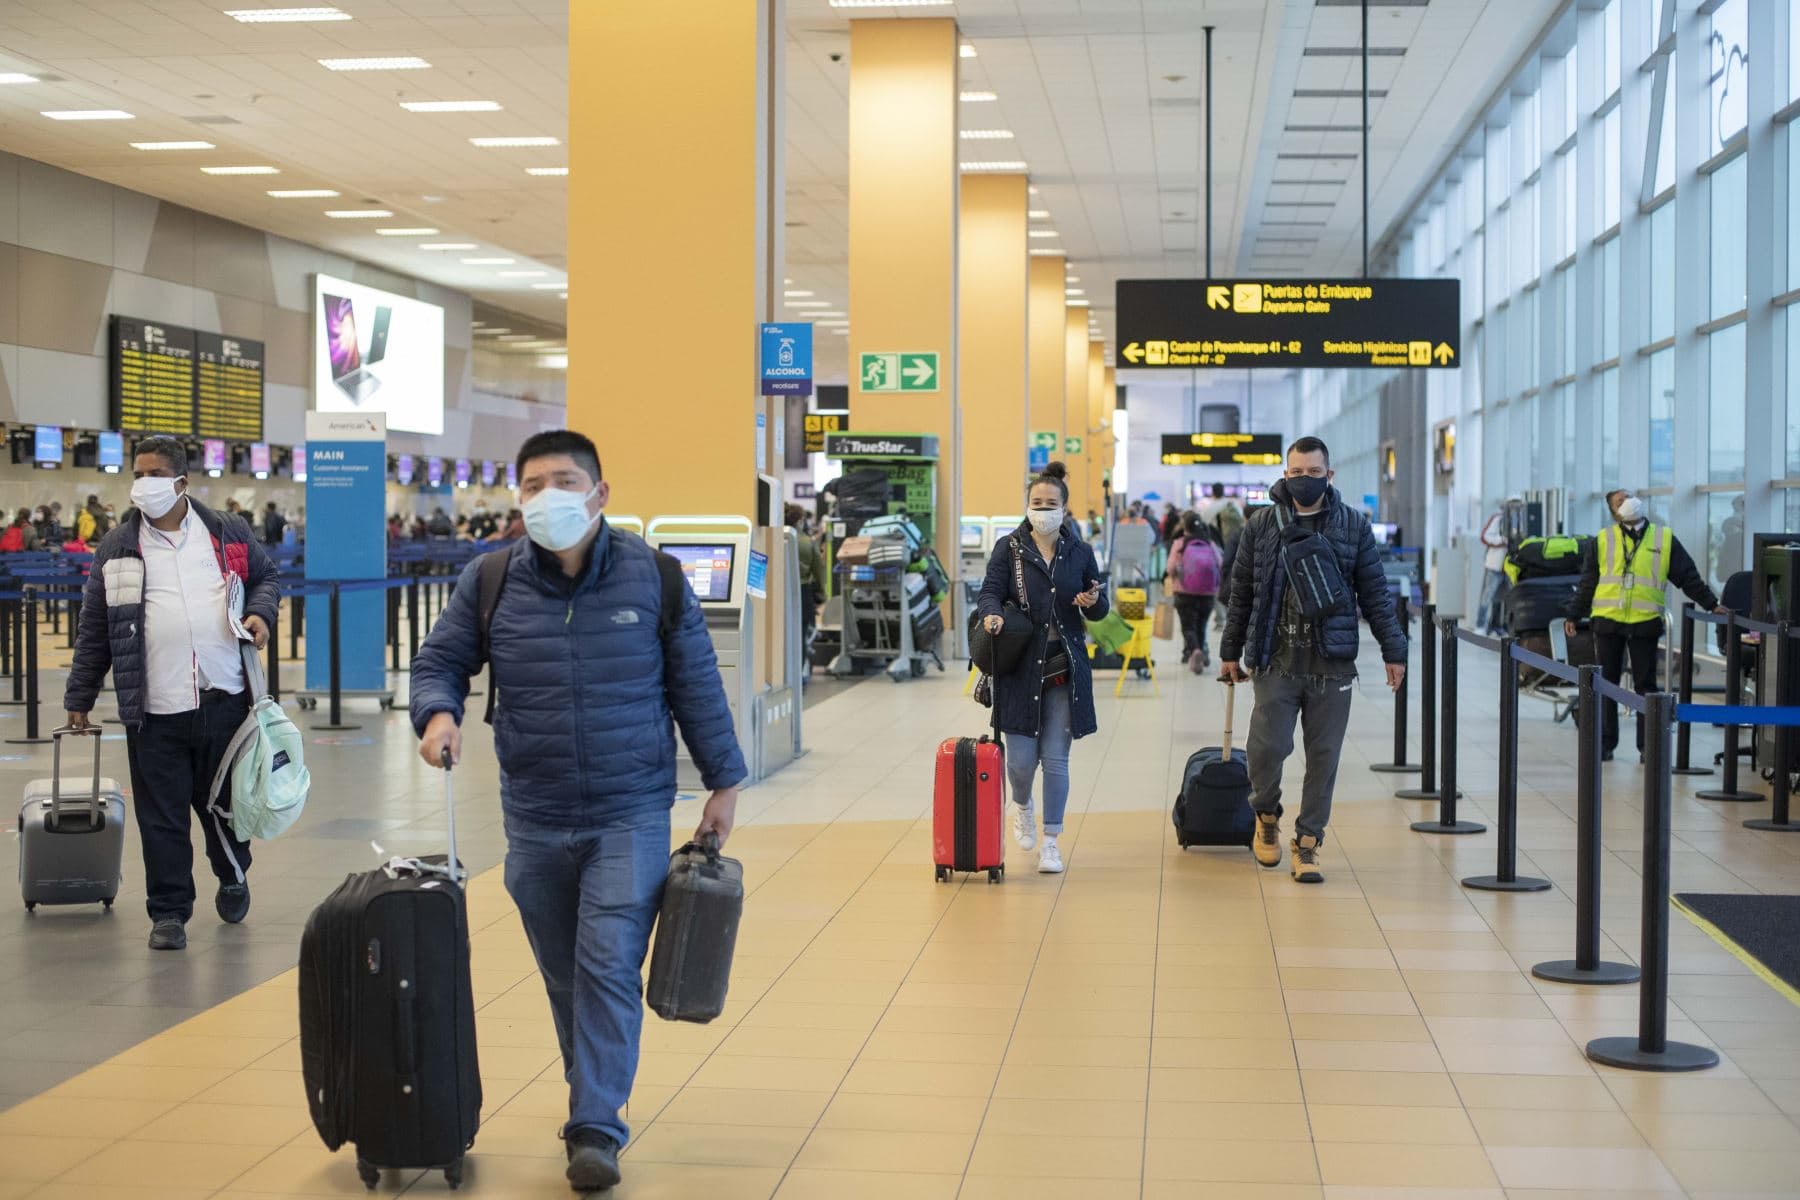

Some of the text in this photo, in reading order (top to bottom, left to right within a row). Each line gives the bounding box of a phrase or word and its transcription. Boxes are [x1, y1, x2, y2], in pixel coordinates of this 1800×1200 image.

[1263, 284, 1372, 301] Puertas de Embarque
[765, 368, 806, 376] ALCOHOL
[328, 422, 366, 431] American
[851, 441, 905, 453] TrueStar
[313, 450, 345, 460] MAIN
